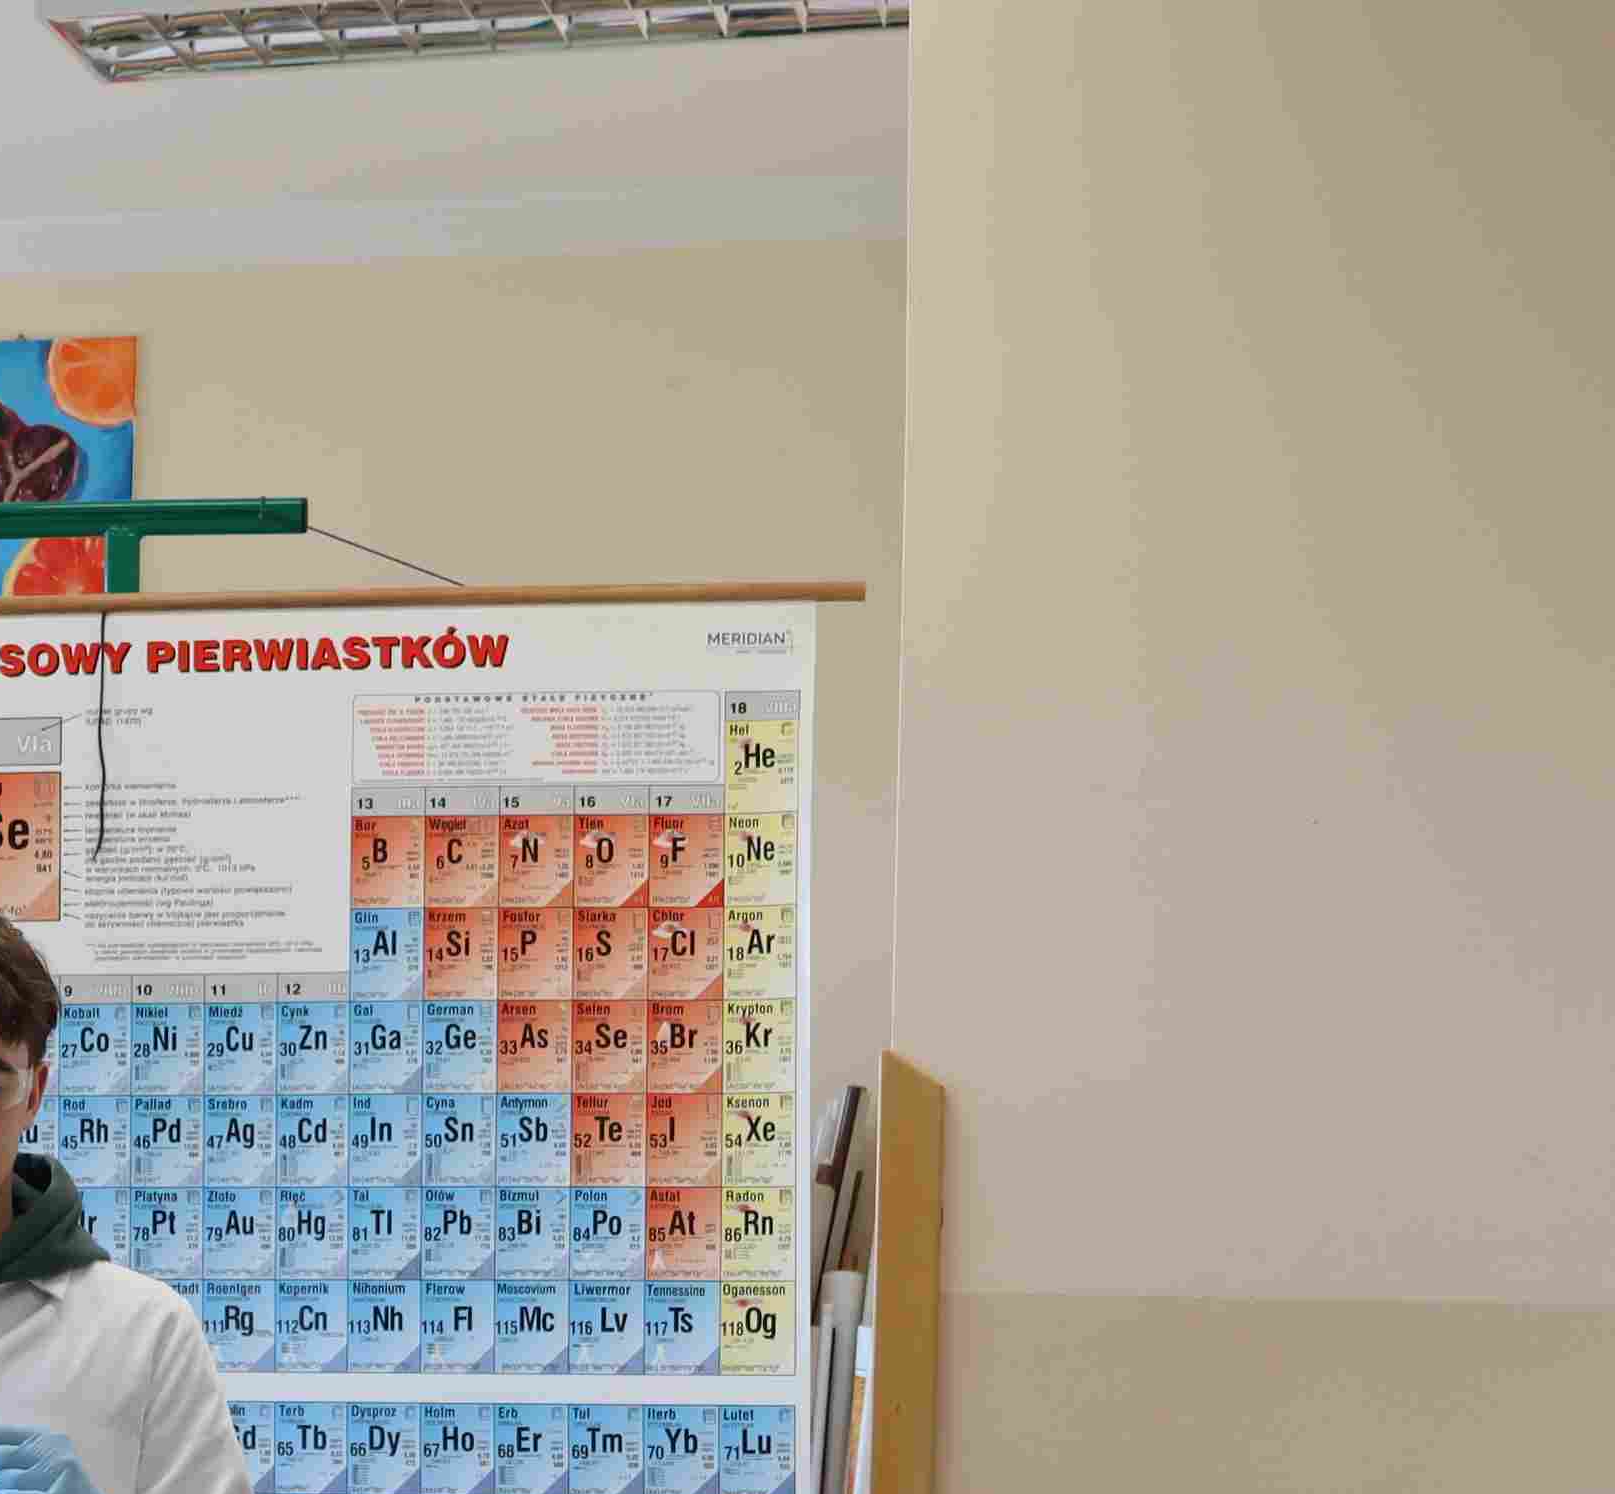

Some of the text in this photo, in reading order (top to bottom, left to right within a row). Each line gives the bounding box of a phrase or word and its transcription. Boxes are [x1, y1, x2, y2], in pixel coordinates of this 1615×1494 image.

[147, 627, 509, 673] PIERWIASTKÓW
[707, 632, 785, 645] MERIDIAN
[731, 702, 747, 714] 18
[744, 742, 775, 768] He
[358, 798, 373, 810] 13
[430, 797, 446, 808] 14
[504, 796, 520, 808] 15
[580, 796, 596, 808] 16
[656, 796, 672, 808] 17
[373, 837, 388, 863] B
[447, 838, 463, 864] C
[522, 837, 538, 863] N
[596, 838, 614, 863] O
[671, 837, 686, 862] F
[744, 835, 775, 861] Ne
[373, 930, 397, 956] Al
[446, 930, 470, 957] Si
[520, 929, 537, 955] P
[596, 930, 612, 956] S
[671, 930, 695, 956] Cl
[747, 929, 775, 954] Ar
[64, 985, 73, 997] 9
[137, 984, 152, 996] 10
[212, 984, 226, 996] 11
[286, 983, 301, 995] 12
[80, 1026, 109, 1053] Co
[153, 1026, 177, 1051] Ni
[226, 1025, 253, 1052] Cu
[299, 1024, 327, 1050] Zn
[371, 1024, 401, 1050] Ga
[445, 1023, 476, 1050] Ge
[520, 1023, 548, 1048] As
[595, 1022, 627, 1049] Se
[670, 1022, 698, 1049] Br
[743, 1020, 772, 1048] Kr
[134, 1043, 151, 1058] 28
[499, 1040, 517, 1055] 33
[80, 1118, 108, 1143] Rh
[152, 1118, 181, 1143] Pd
[226, 1117, 254, 1149] Ag
[298, 1117, 327, 1143] Cd
[370, 1116, 392, 1142] In
[444, 1116, 474, 1143] Sn
[519, 1116, 548, 1142] Sb
[594, 1116, 622, 1142] Te
[725, 1133, 742, 1148] 54
[743, 1113, 775, 1142] Xe
[206, 1135, 223, 1149] 47
[152, 1210, 176, 1235] Pt
[225, 1210, 254, 1235] Au
[297, 1209, 325, 1241] Hg
[443, 1209, 472, 1235] Pb
[517, 1209, 541, 1235] Bi
[593, 1210, 622, 1236] Po
[668, 1210, 695, 1236] At
[741, 1207, 773, 1235] Rn
[352, 1227, 367, 1242] 81
[224, 1305, 254, 1336] Rg
[299, 1305, 327, 1331] Cn
[373, 1305, 403, 1331] Nh
[519, 1306, 554, 1332] Mc
[601, 1307, 628, 1332] Lv
[668, 1307, 693, 1333] Ts
[745, 1307, 776, 1339] Og
[297, 1424, 327, 1450] Tb
[369, 1425, 401, 1457] Dy
[442, 1426, 474, 1452] Ho
[516, 1426, 542, 1452] Er
[586, 1427, 622, 1453] Tm
[665, 1428, 698, 1454] Yb
[742, 1428, 771, 1455] Lu
